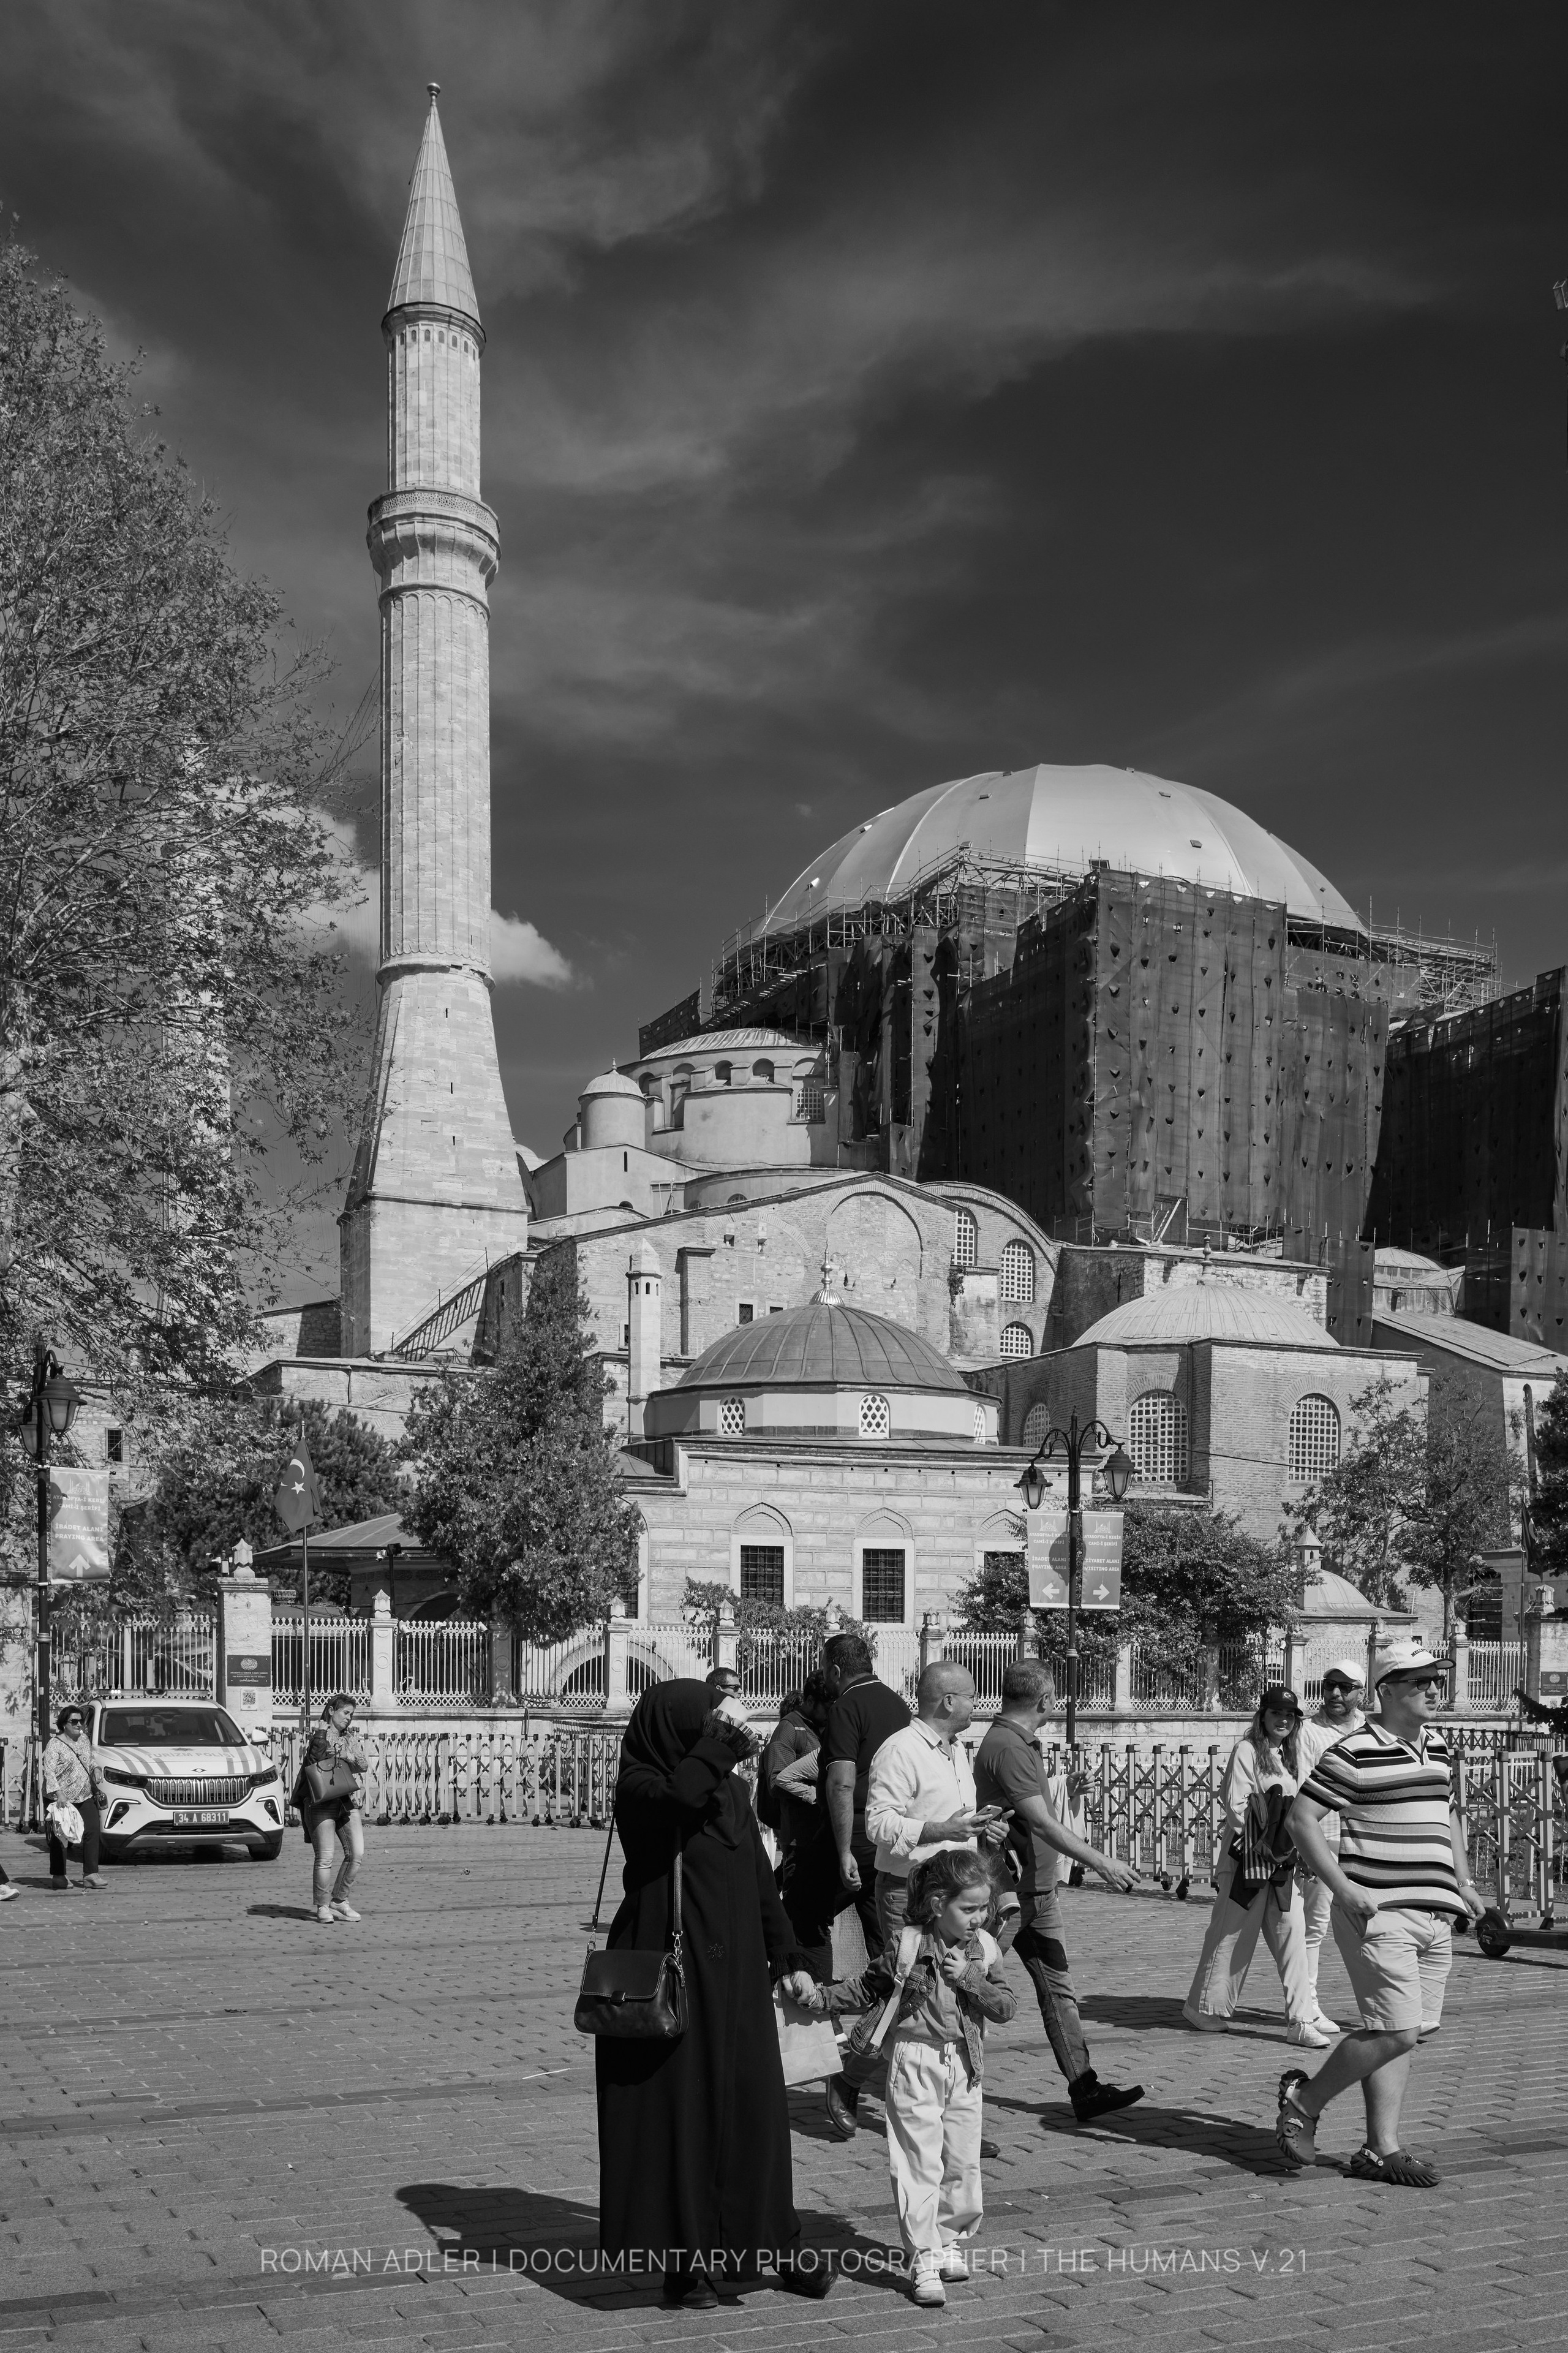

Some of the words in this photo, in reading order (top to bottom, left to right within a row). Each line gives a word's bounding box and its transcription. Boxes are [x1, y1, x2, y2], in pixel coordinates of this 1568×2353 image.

[178, 1813, 189, 1822] 34
[192, 1813, 198, 1822] A
[201, 1812, 226, 1822] 68311
